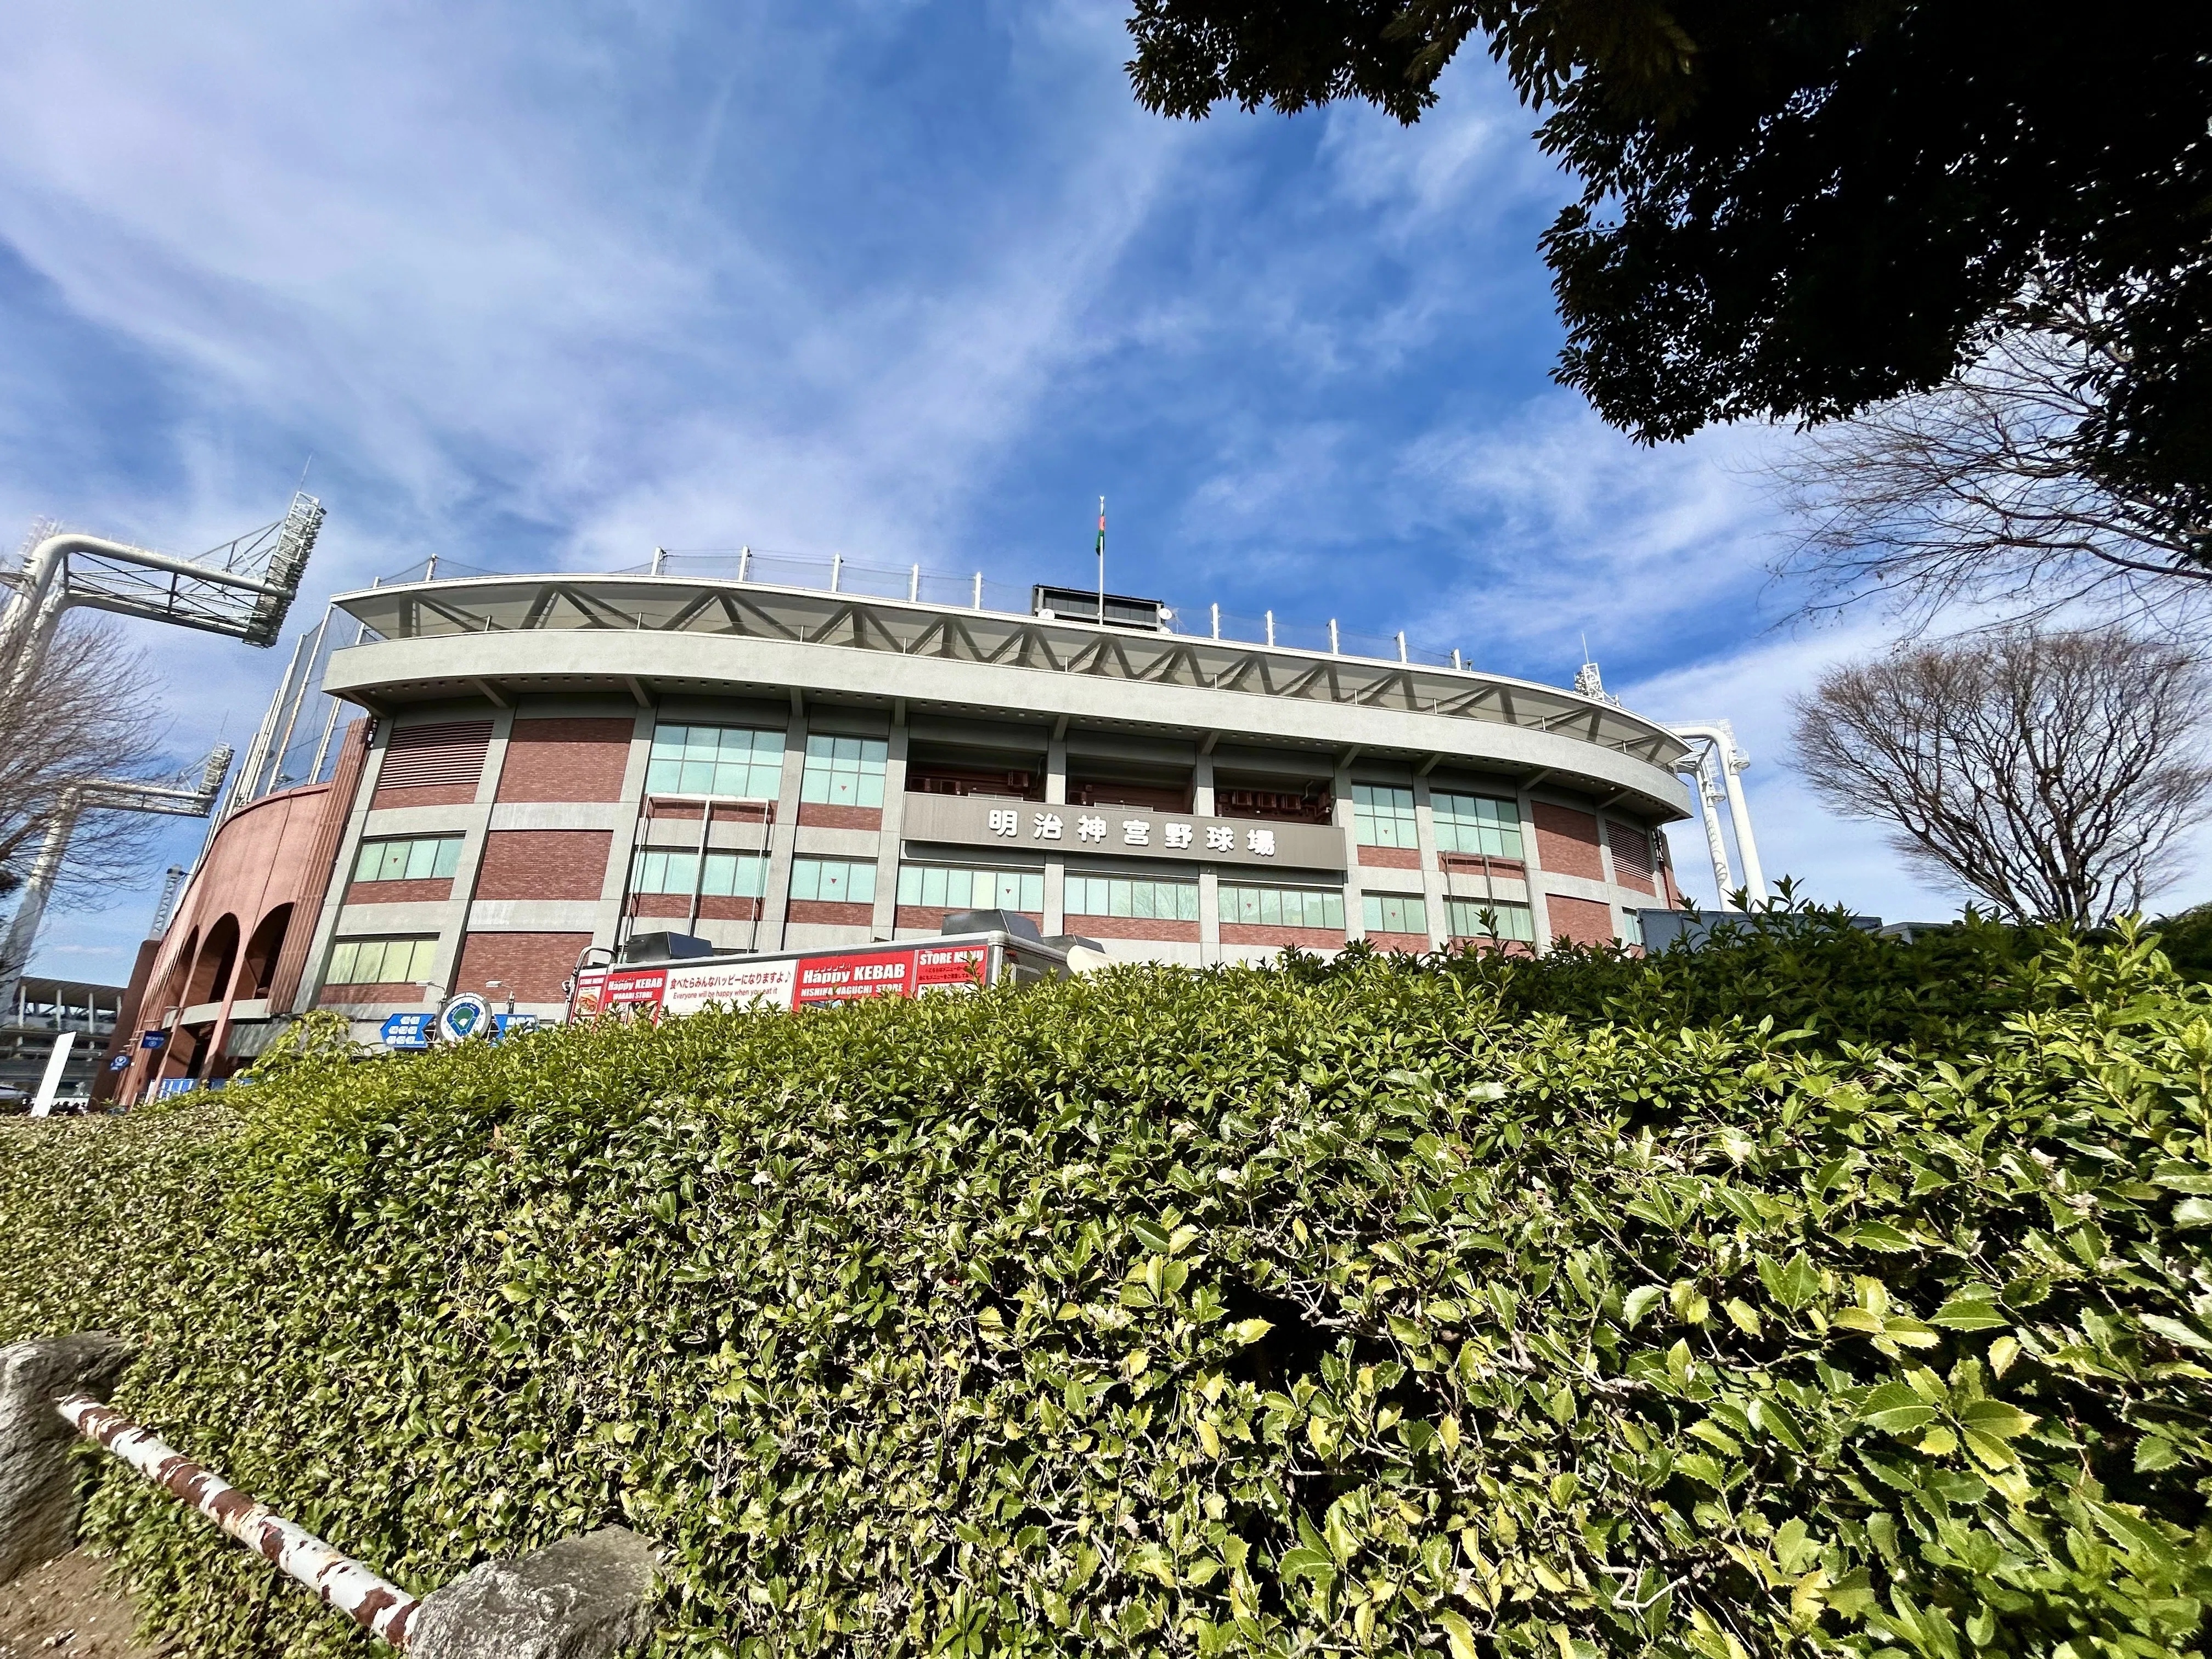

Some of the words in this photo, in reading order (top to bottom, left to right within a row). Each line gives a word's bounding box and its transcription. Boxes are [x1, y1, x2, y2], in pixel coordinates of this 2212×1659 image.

[989, 809, 1276, 856] 明治神宮野球場
[919, 952, 953, 966] STORE
[803, 969, 850, 984] Happy
[853, 963, 905, 981] KEBAB
[608, 980, 634, 991] Happy
[635, 977, 663, 990] KEBAB
[876, 983, 904, 994] STORE
[635, 991, 653, 999] STORE
[673, 992, 697, 1000] Everyone
